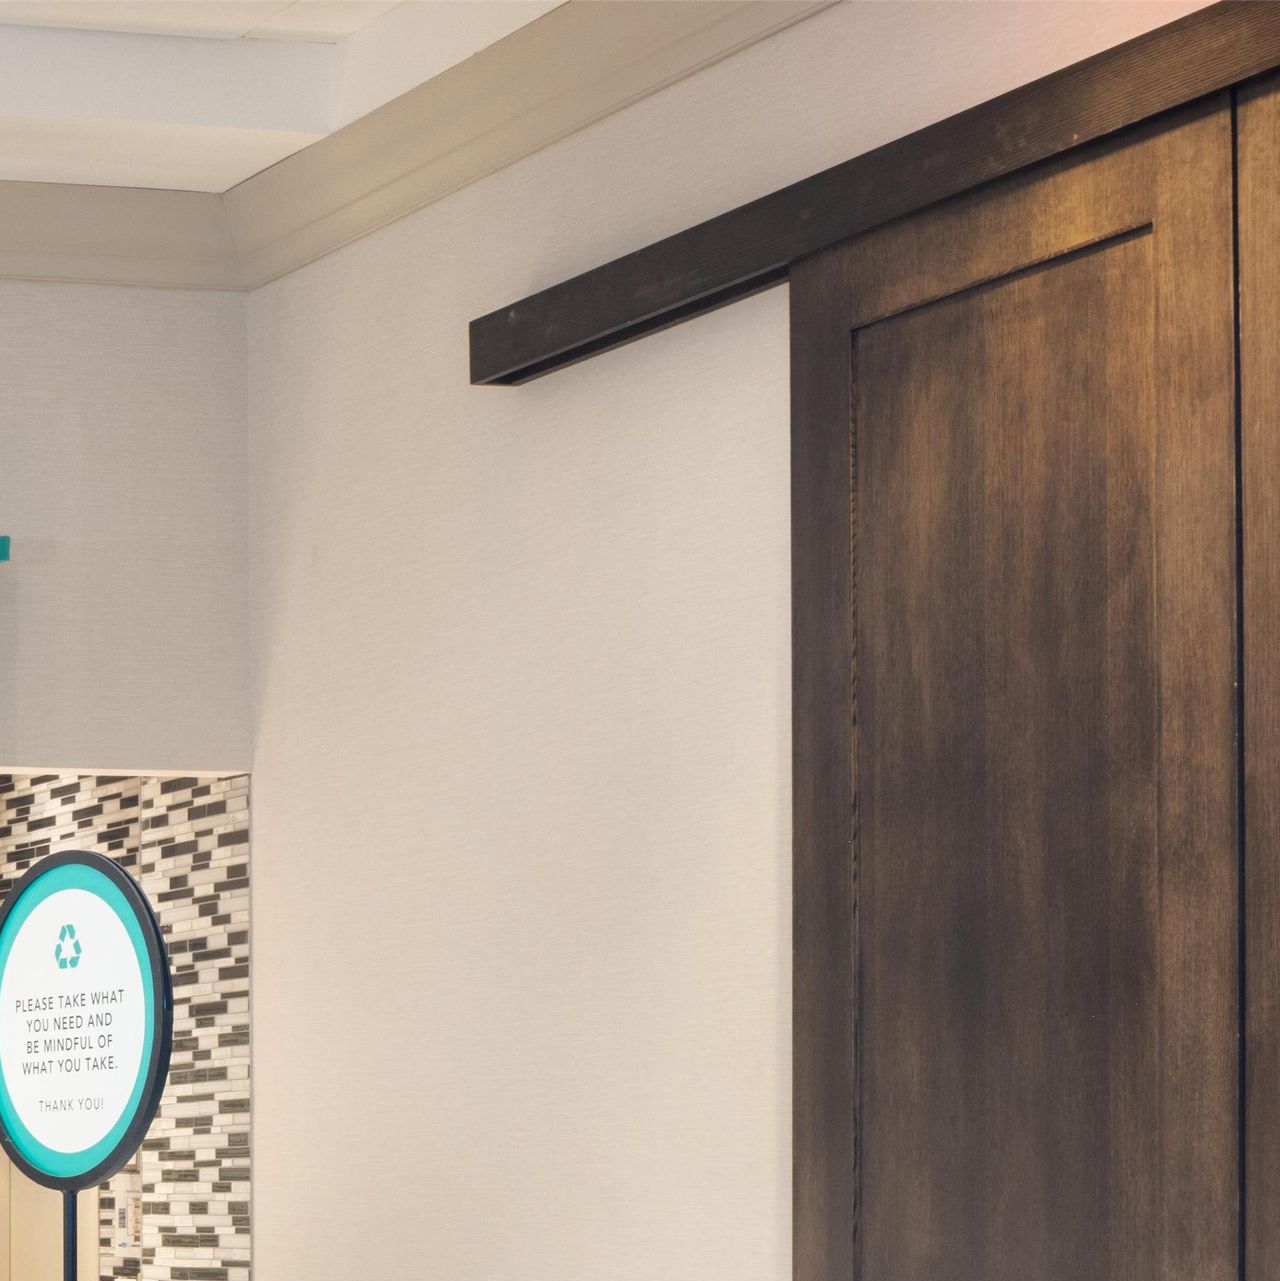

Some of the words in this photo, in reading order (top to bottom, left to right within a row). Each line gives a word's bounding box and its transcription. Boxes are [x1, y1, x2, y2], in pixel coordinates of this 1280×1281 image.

[15, 996, 53, 1013] PLEASE
[57, 993, 86, 1008] TAKE
[90, 989, 124, 1005] WHAT
[26, 1019, 49, 1033] YOU
[53, 1015, 83, 1030] NEED
[87, 1012, 113, 1028] AND
[26, 1040, 39, 1054] BE
[44, 1036, 94, 1052] MINDFUL
[97, 1034, 113, 1049] OF
[22, 1060, 54, 1075] WHAT
[57, 1058, 81, 1073] YOU
[85, 1055, 118, 1071] TAKE.
[38, 1099, 74, 1112] THANK
[78, 1097, 104, 1111] YOU!
